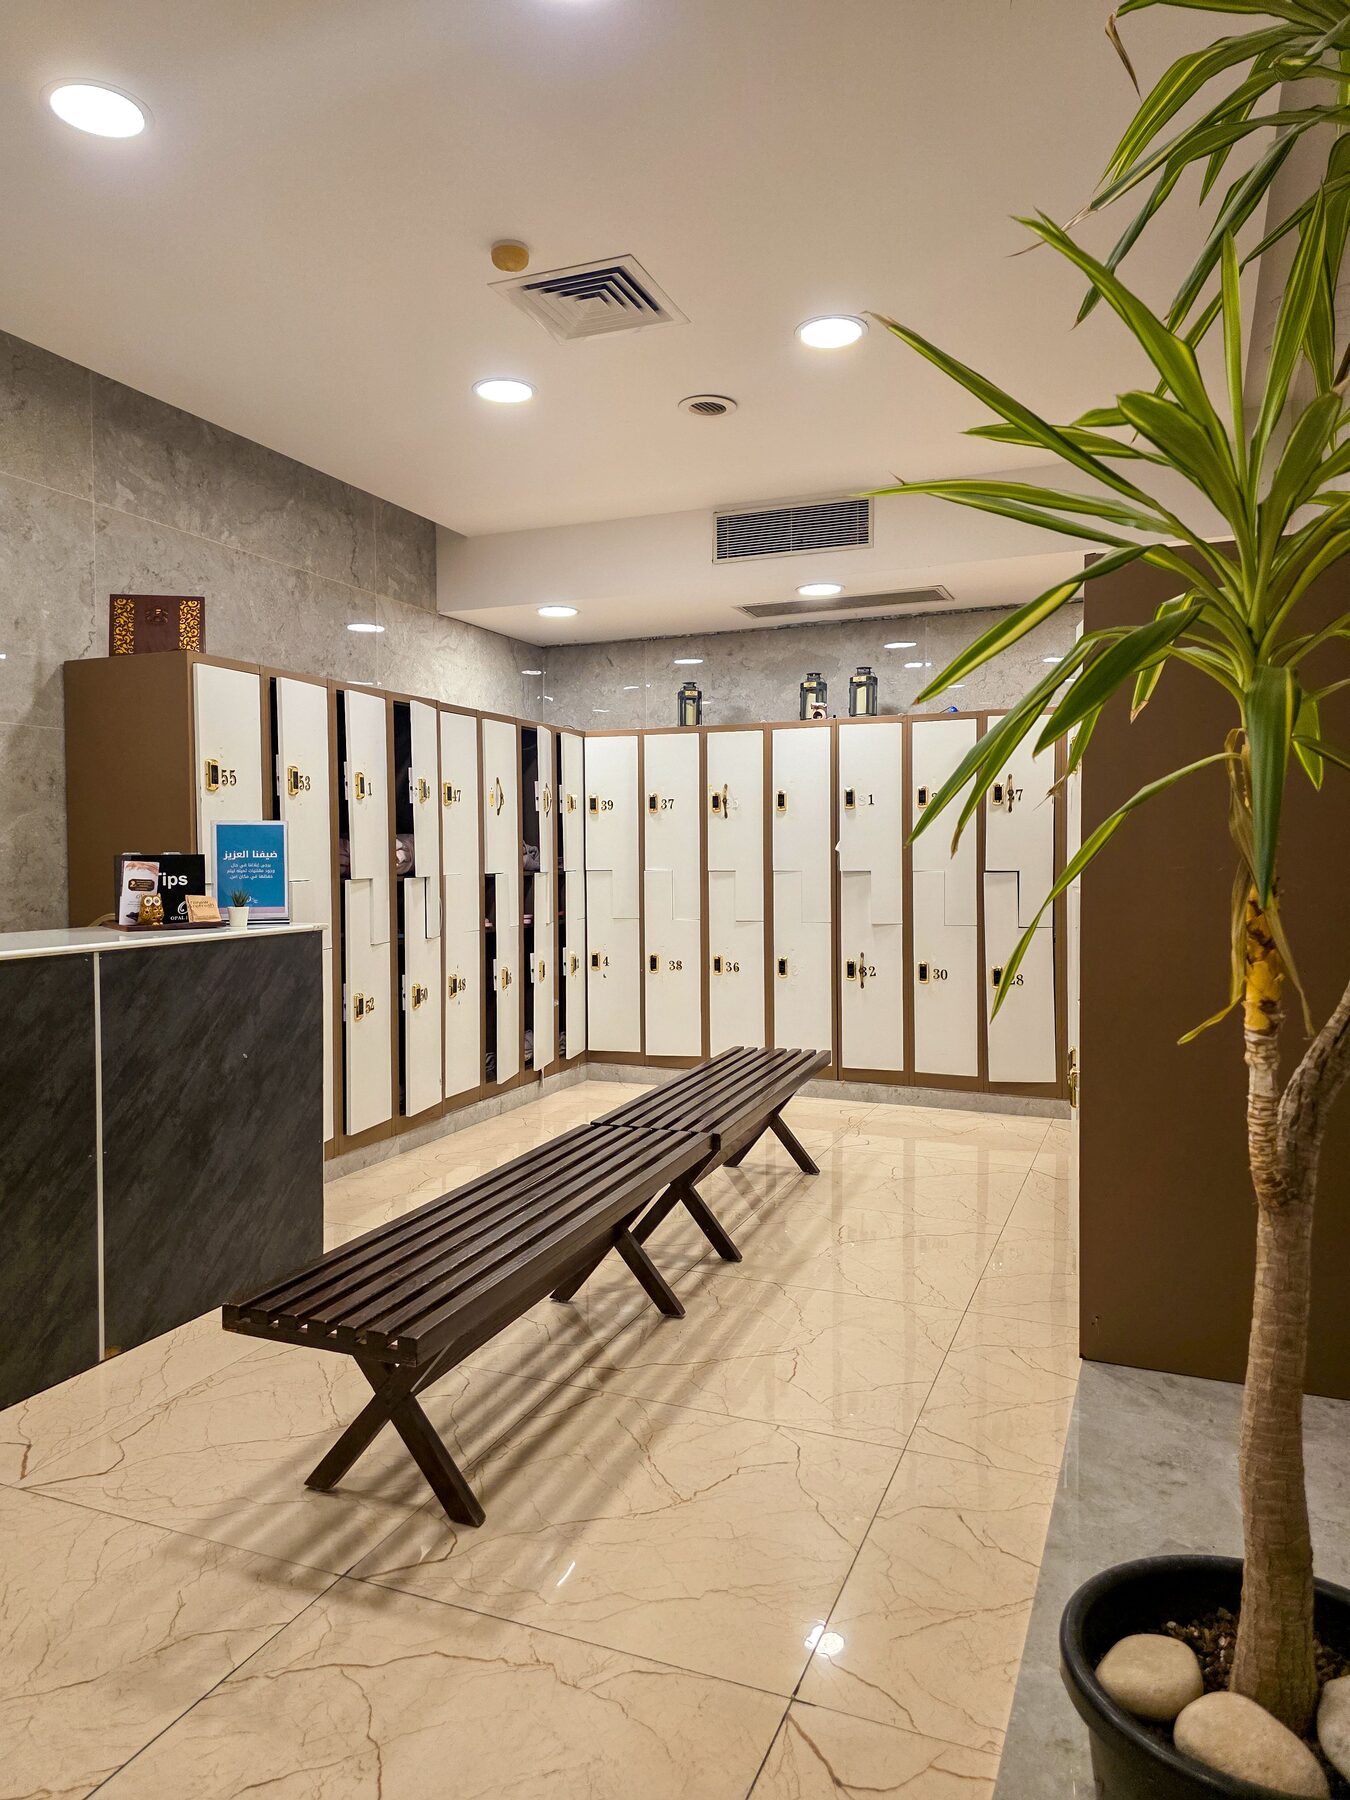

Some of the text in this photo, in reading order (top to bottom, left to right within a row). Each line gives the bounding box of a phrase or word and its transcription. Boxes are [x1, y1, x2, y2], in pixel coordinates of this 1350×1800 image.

[221, 769, 237, 786] 55
[299, 775, 311, 791] 53
[601, 799, 614, 811] 39
[661, 798, 675, 810] 37
[223, 850, 278, 860] ضيفنا العزيز
[668, 960, 683, 972] 38
[725, 961, 740, 973] 36
[933, 968, 948, 981] 30
[365, 997, 375, 1014] 52
